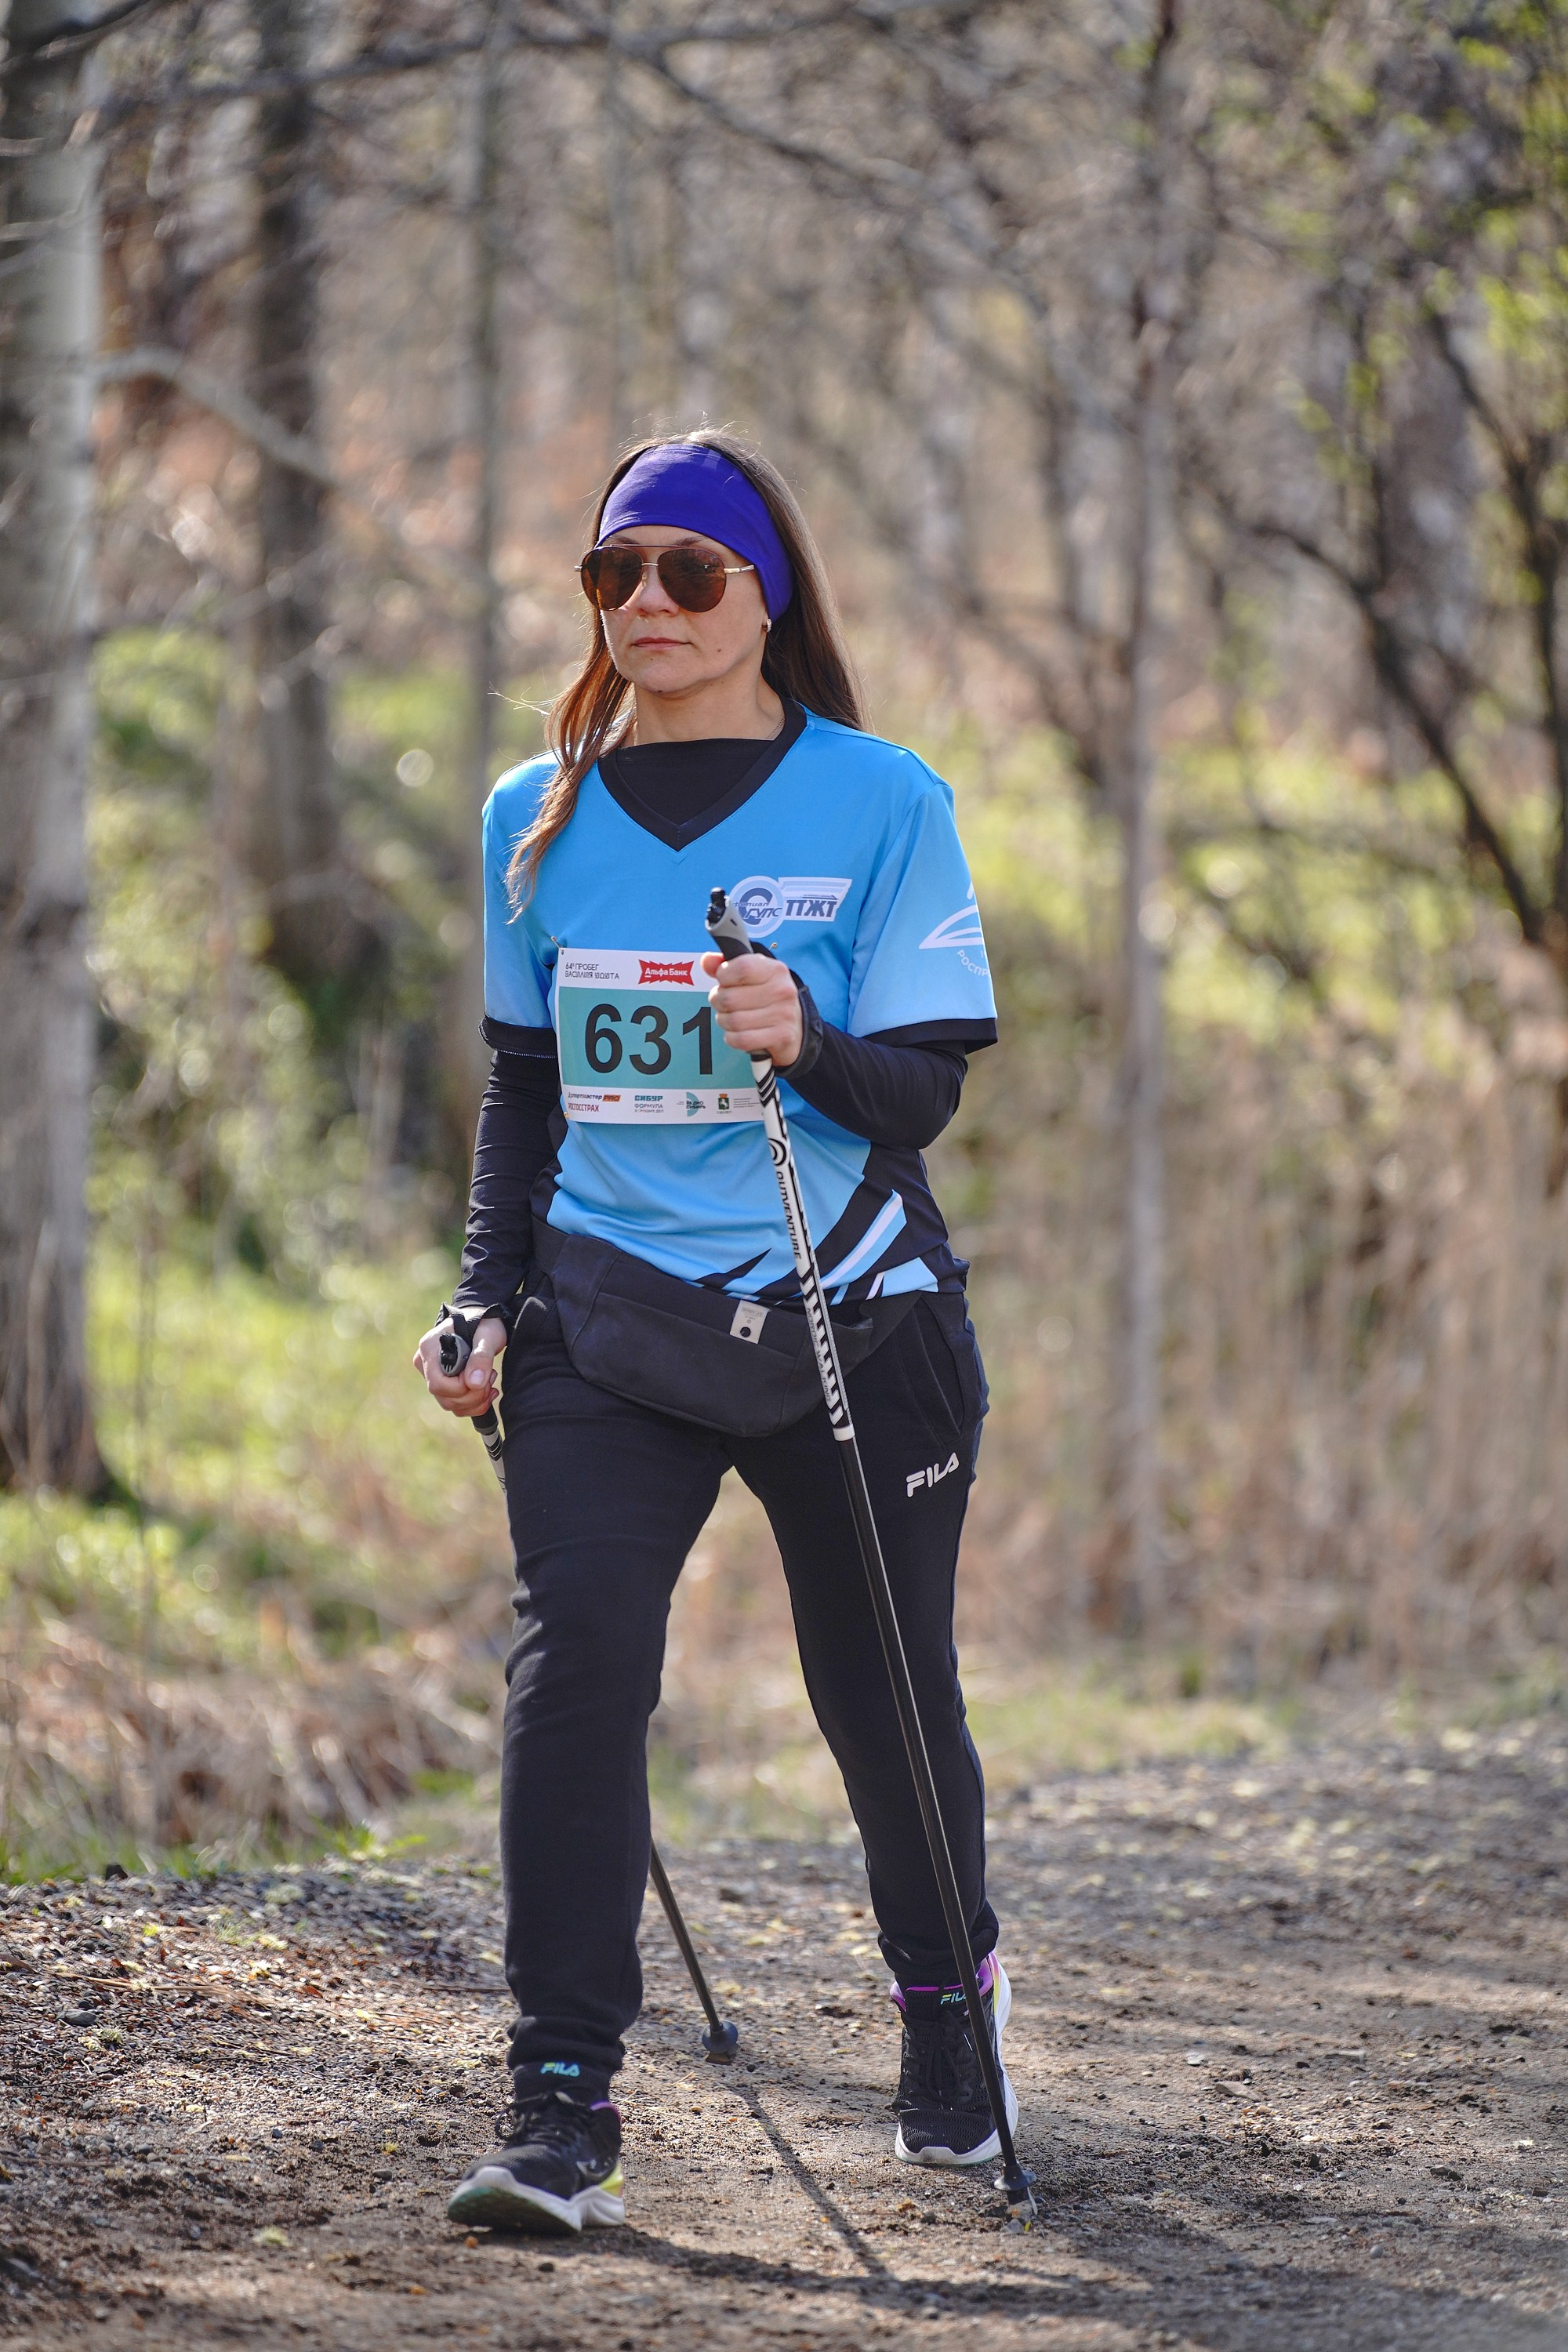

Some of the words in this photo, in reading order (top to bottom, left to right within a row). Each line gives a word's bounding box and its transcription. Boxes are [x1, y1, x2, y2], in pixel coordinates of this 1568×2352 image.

[575, 963, 599, 971] ПРОБЕГ
[644, 967, 668, 978] Альфа
[585, 1003, 713, 1076] 631
[568, 1102, 599, 1112] РОСГОССТРАХ
[776, 1171, 801, 1260] OUTVENTURE
[906, 1452, 960, 1497] FILA
[540, 2062, 580, 2078] FILA
